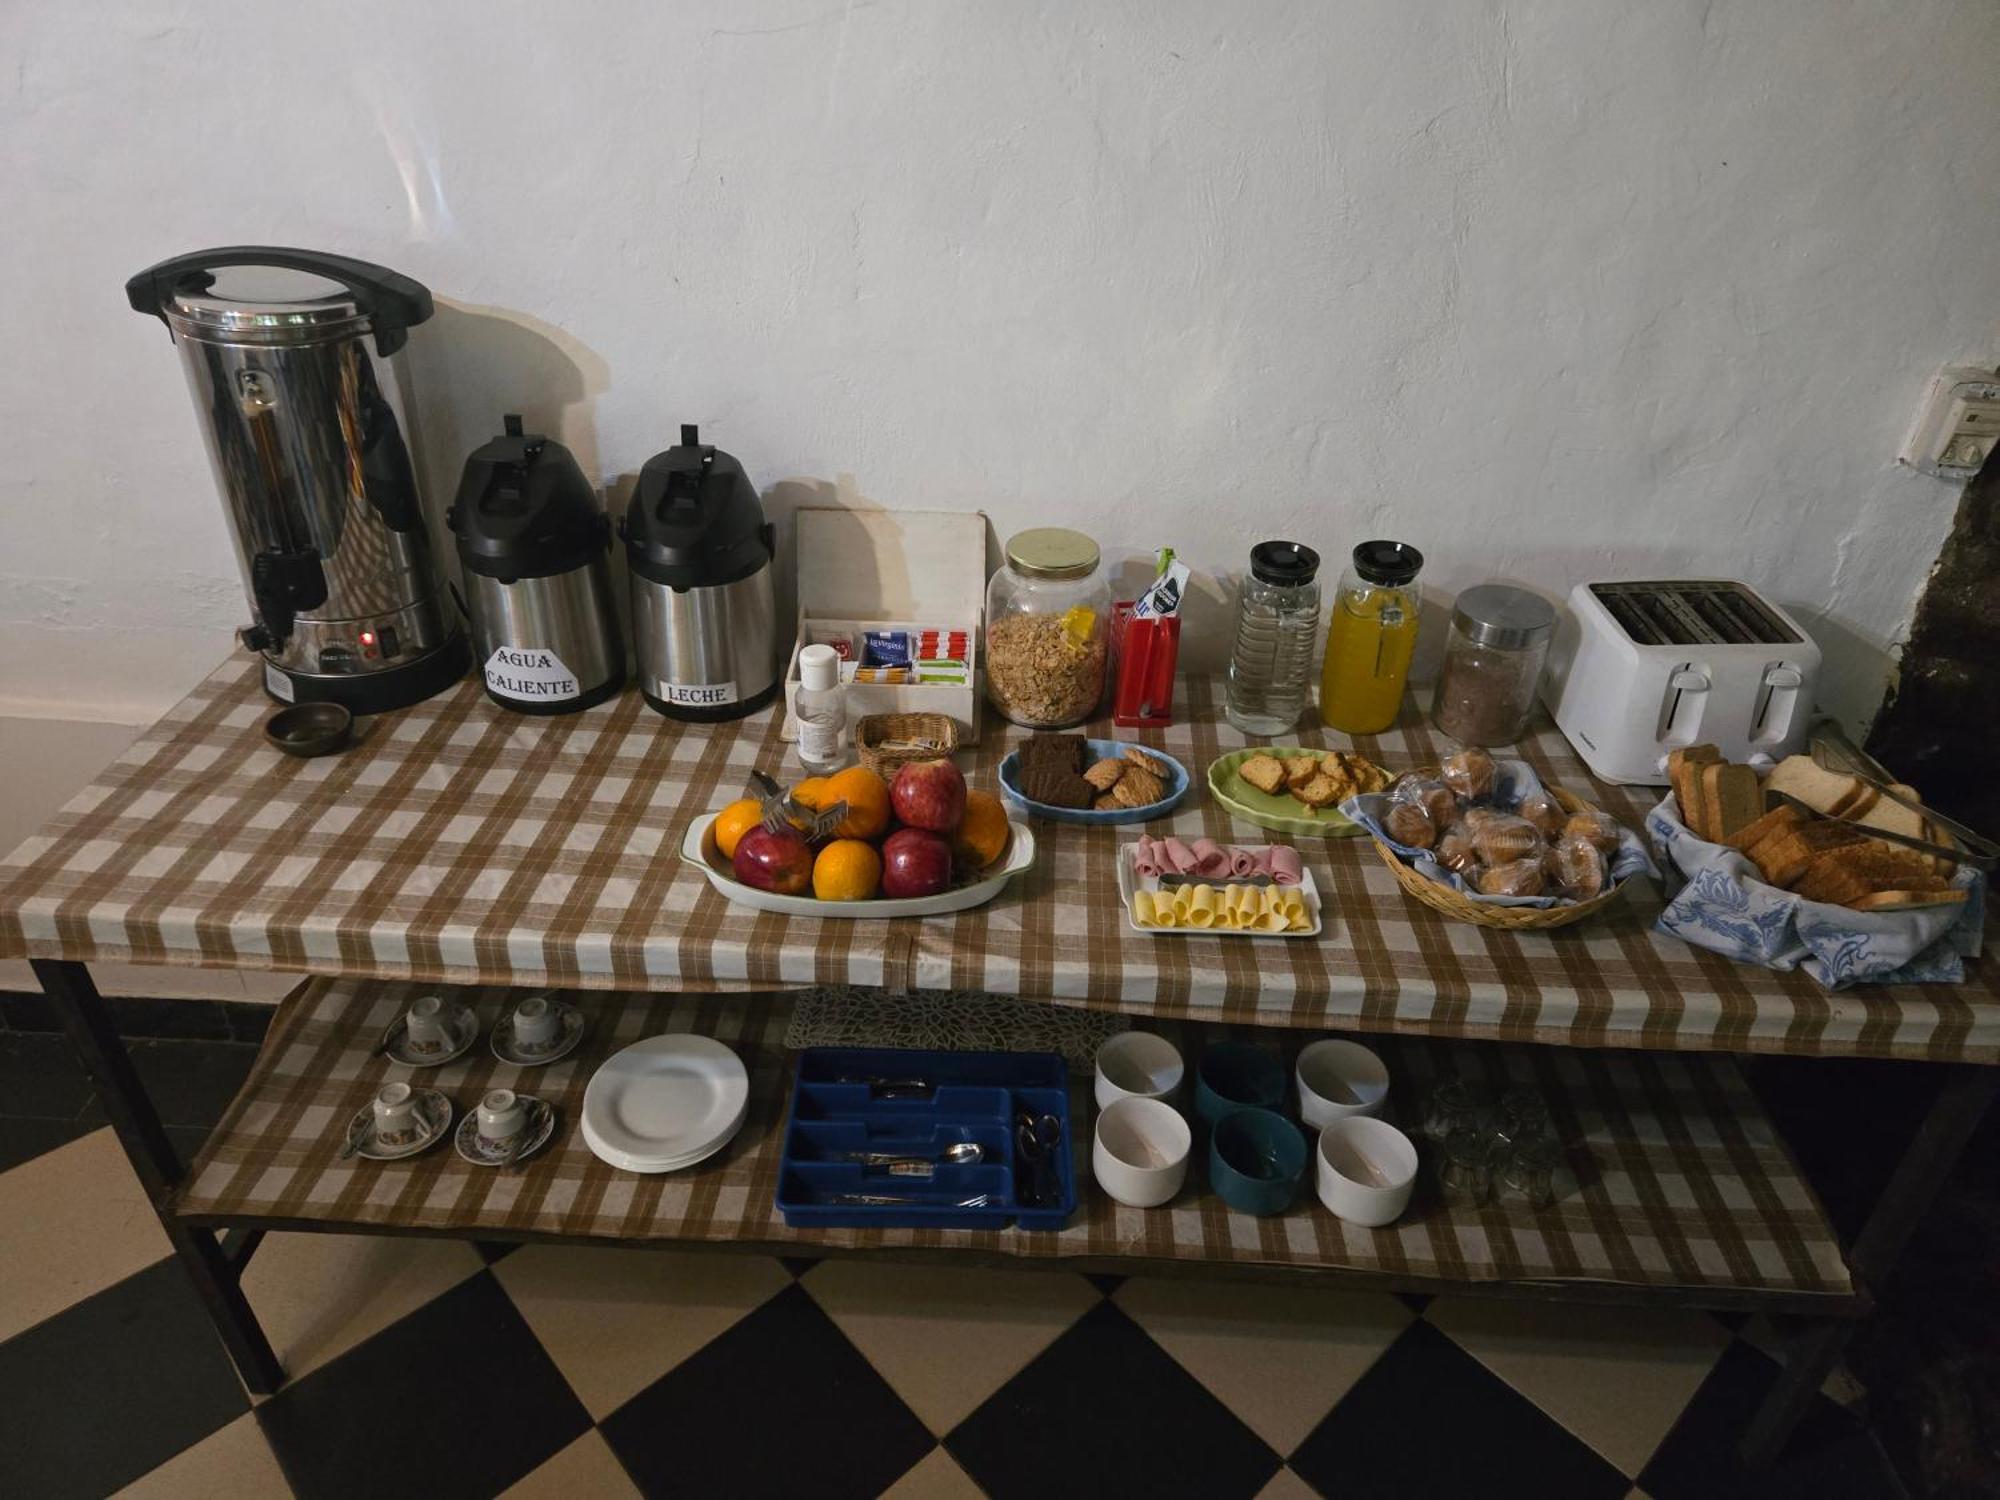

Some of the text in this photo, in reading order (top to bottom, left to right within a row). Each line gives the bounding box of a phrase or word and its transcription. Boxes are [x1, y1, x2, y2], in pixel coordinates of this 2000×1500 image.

[498, 650, 552, 668] AGUA
[487, 670, 574, 694] CALIENTE
[668, 686, 727, 702] LECHE
